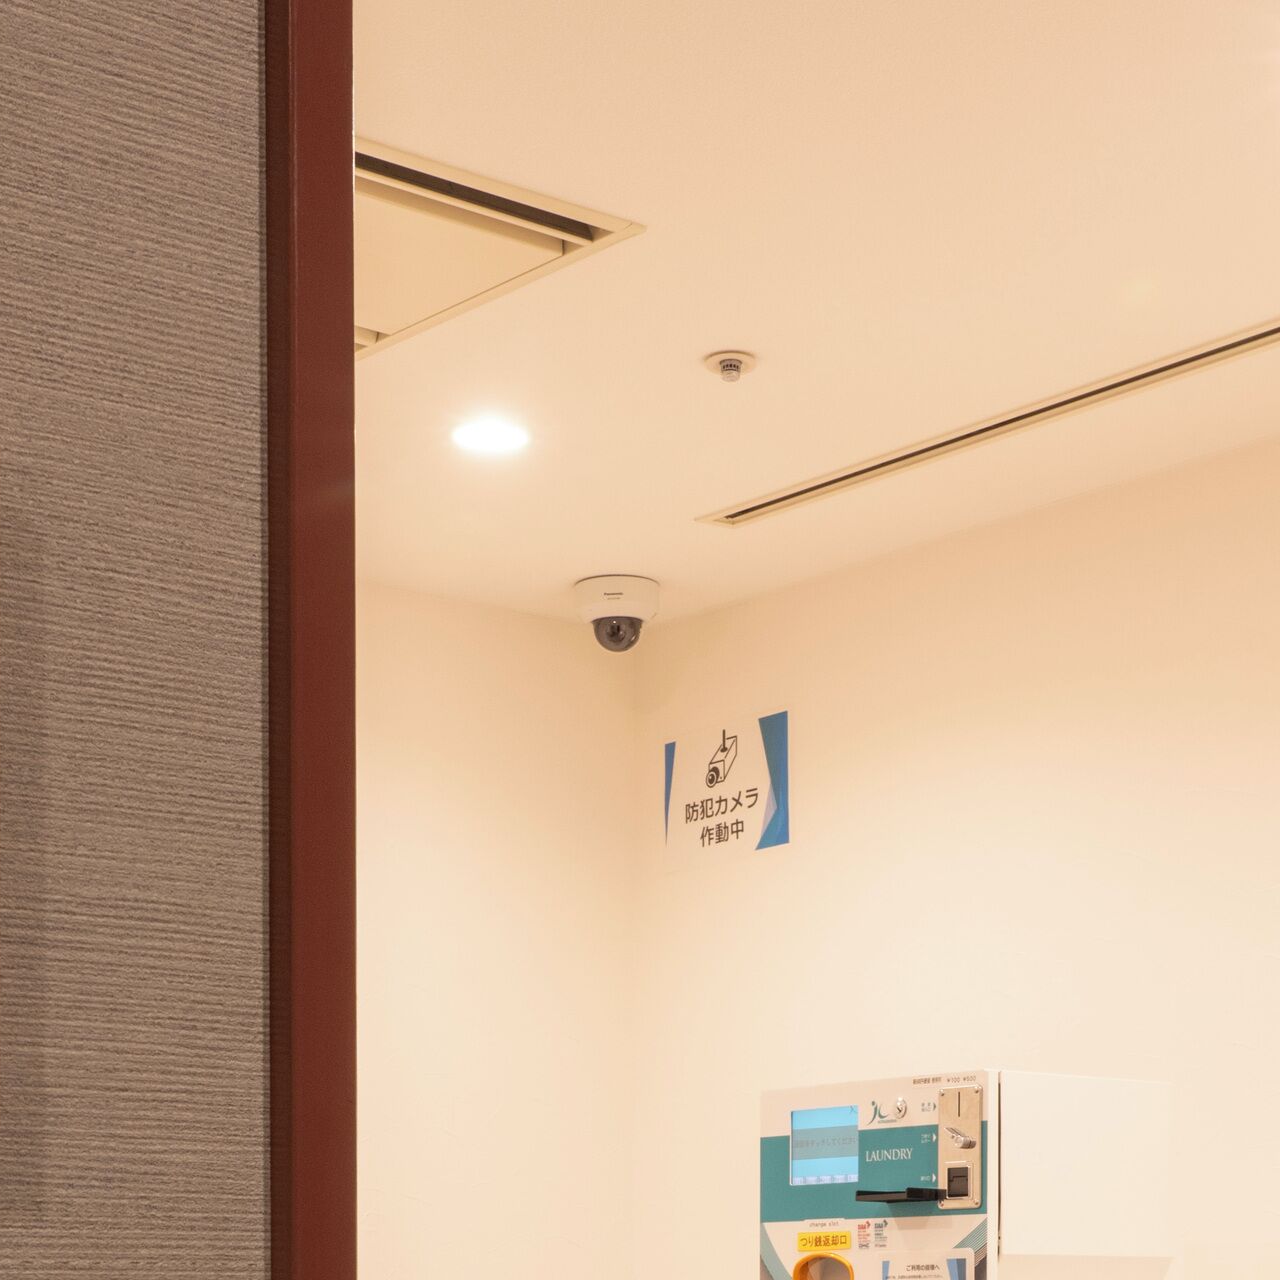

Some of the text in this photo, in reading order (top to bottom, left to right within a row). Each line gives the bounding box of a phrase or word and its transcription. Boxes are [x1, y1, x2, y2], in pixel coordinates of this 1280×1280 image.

[684, 787, 759, 824] 防犯カメラ
[699, 818, 745, 848] 作動中
[865, 1148, 913, 1162] LAUNDRY
[800, 1235, 847, 1248] つり銭返却口
